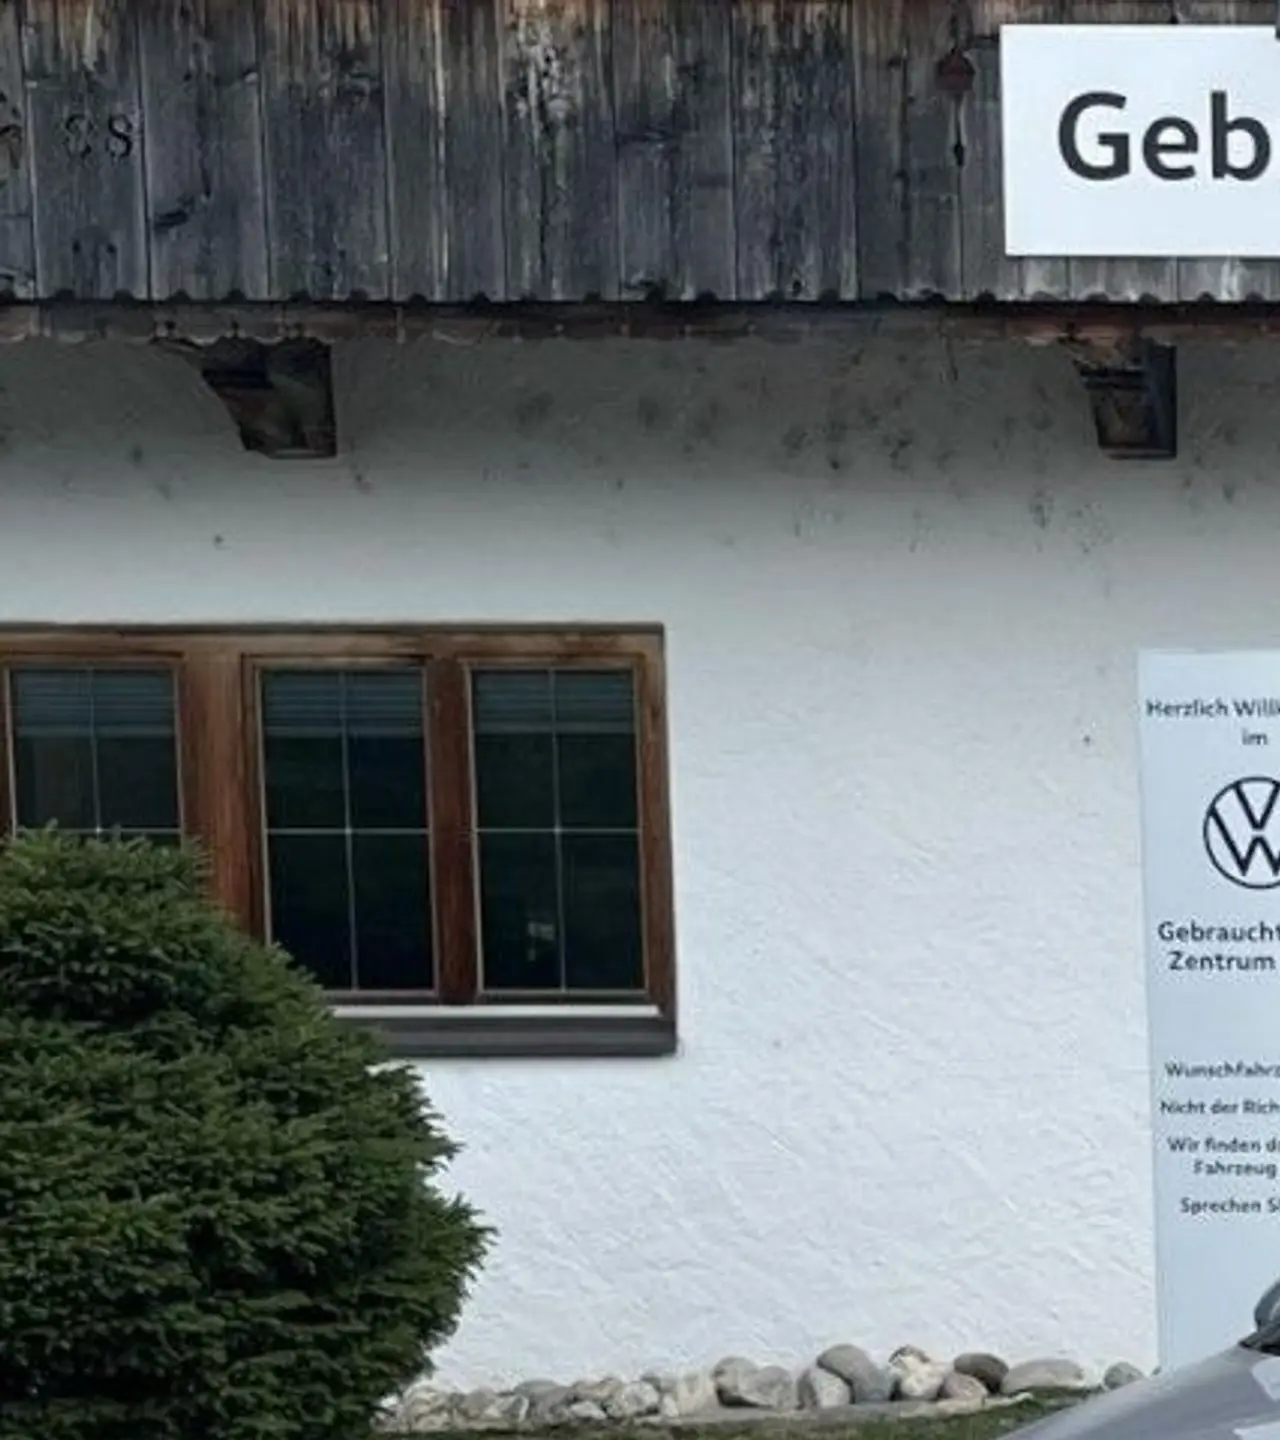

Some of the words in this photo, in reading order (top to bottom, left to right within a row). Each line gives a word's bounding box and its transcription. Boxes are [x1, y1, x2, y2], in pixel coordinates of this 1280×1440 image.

[1145, 697, 1229, 718] Herzlich
[1241, 728, 1269, 746] im
[1167, 948, 1276, 972] Zentrum
[1160, 1099, 1206, 1114] Nicht
[1210, 1099, 1239, 1115] der
[1166, 1137, 1201, 1152] Wir
[1205, 1136, 1262, 1153] finden
[1193, 1159, 1277, 1180] Fahrzeug
[1180, 1196, 1262, 1217] Sprechen
